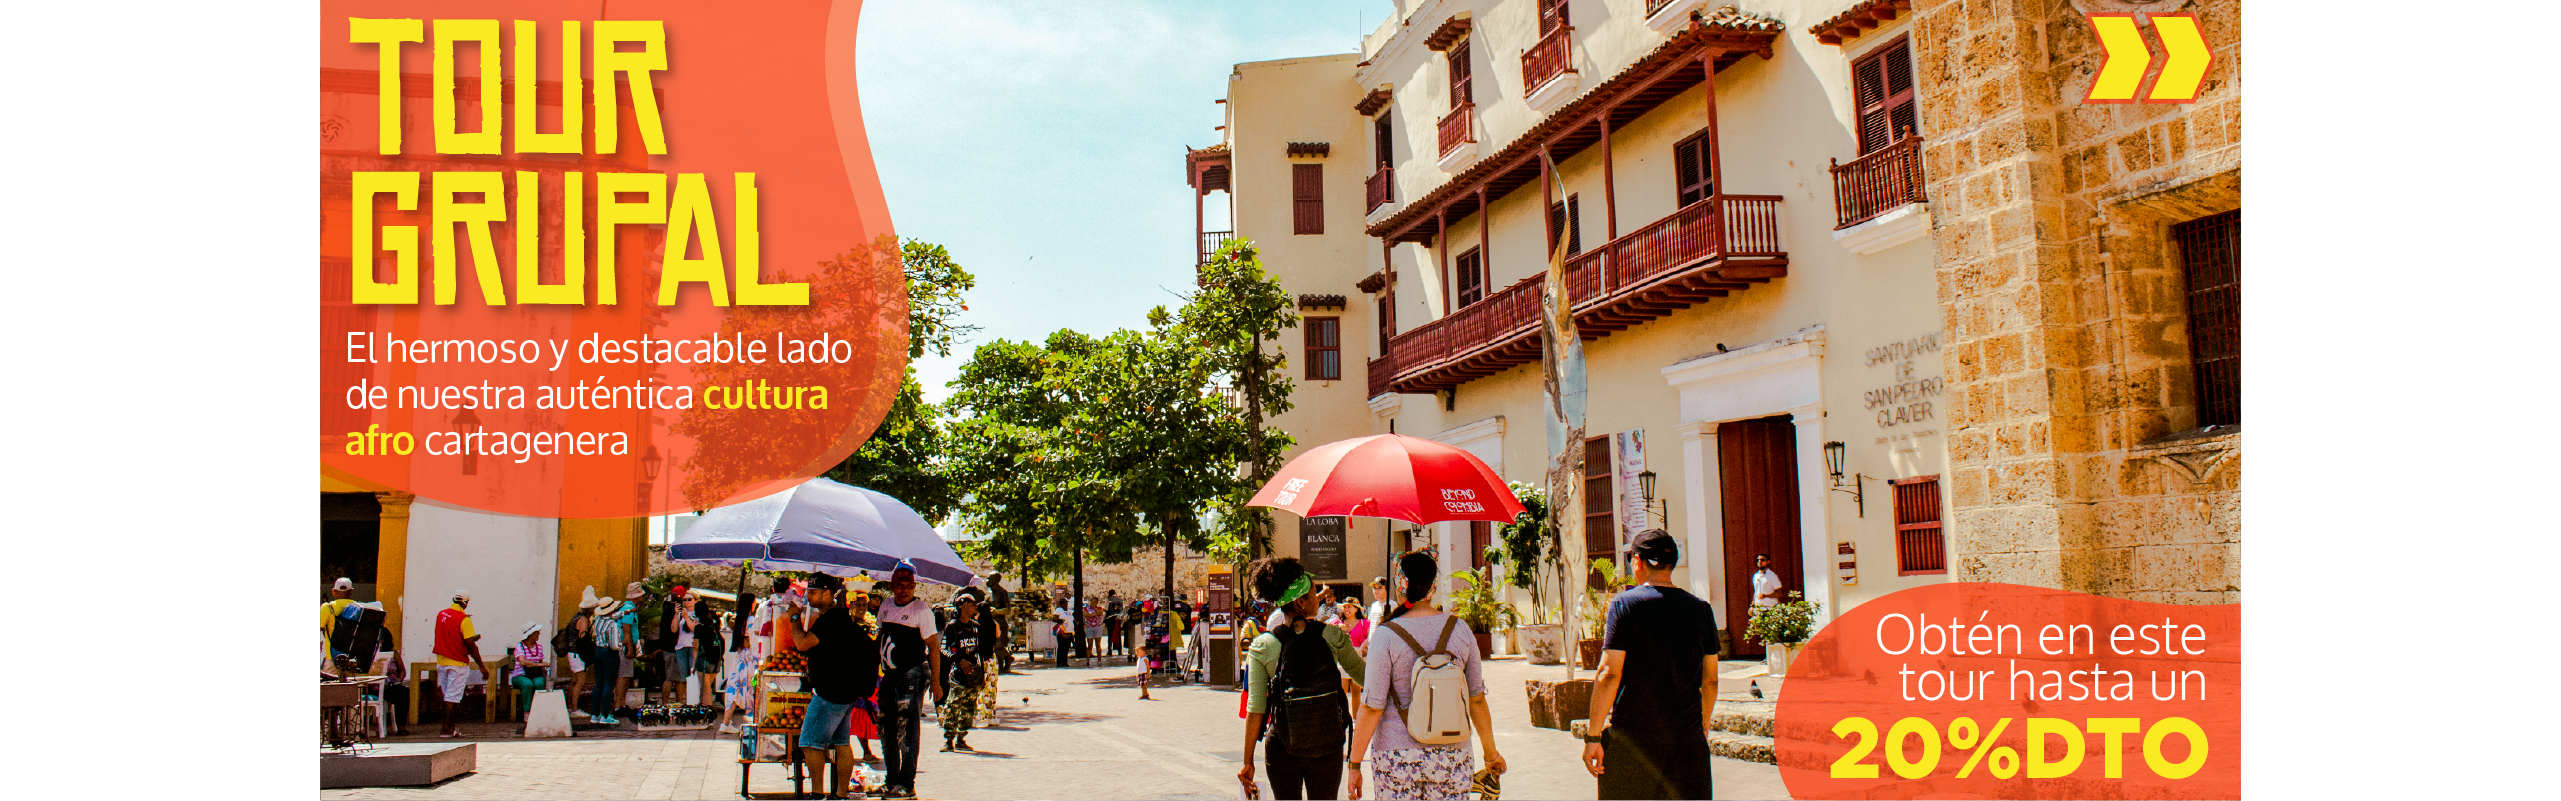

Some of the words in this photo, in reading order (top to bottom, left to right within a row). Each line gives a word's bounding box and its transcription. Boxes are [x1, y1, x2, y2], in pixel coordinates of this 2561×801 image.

[1865, 332, 1942, 368] SANTUARIO
[1895, 360, 1914, 382] DE
[1864, 386, 1892, 410] SAN
[1894, 376, 1943, 403] PEDRO
[1877, 401, 1933, 428] CLAVER
[1283, 478, 1309, 492] FREE
[1274, 490, 1298, 505] TOUR
[1440, 488, 1476, 500] BEYOND
[1443, 501, 1486, 512] COLOMBIA
[1307, 535, 1340, 543] BLANCA
